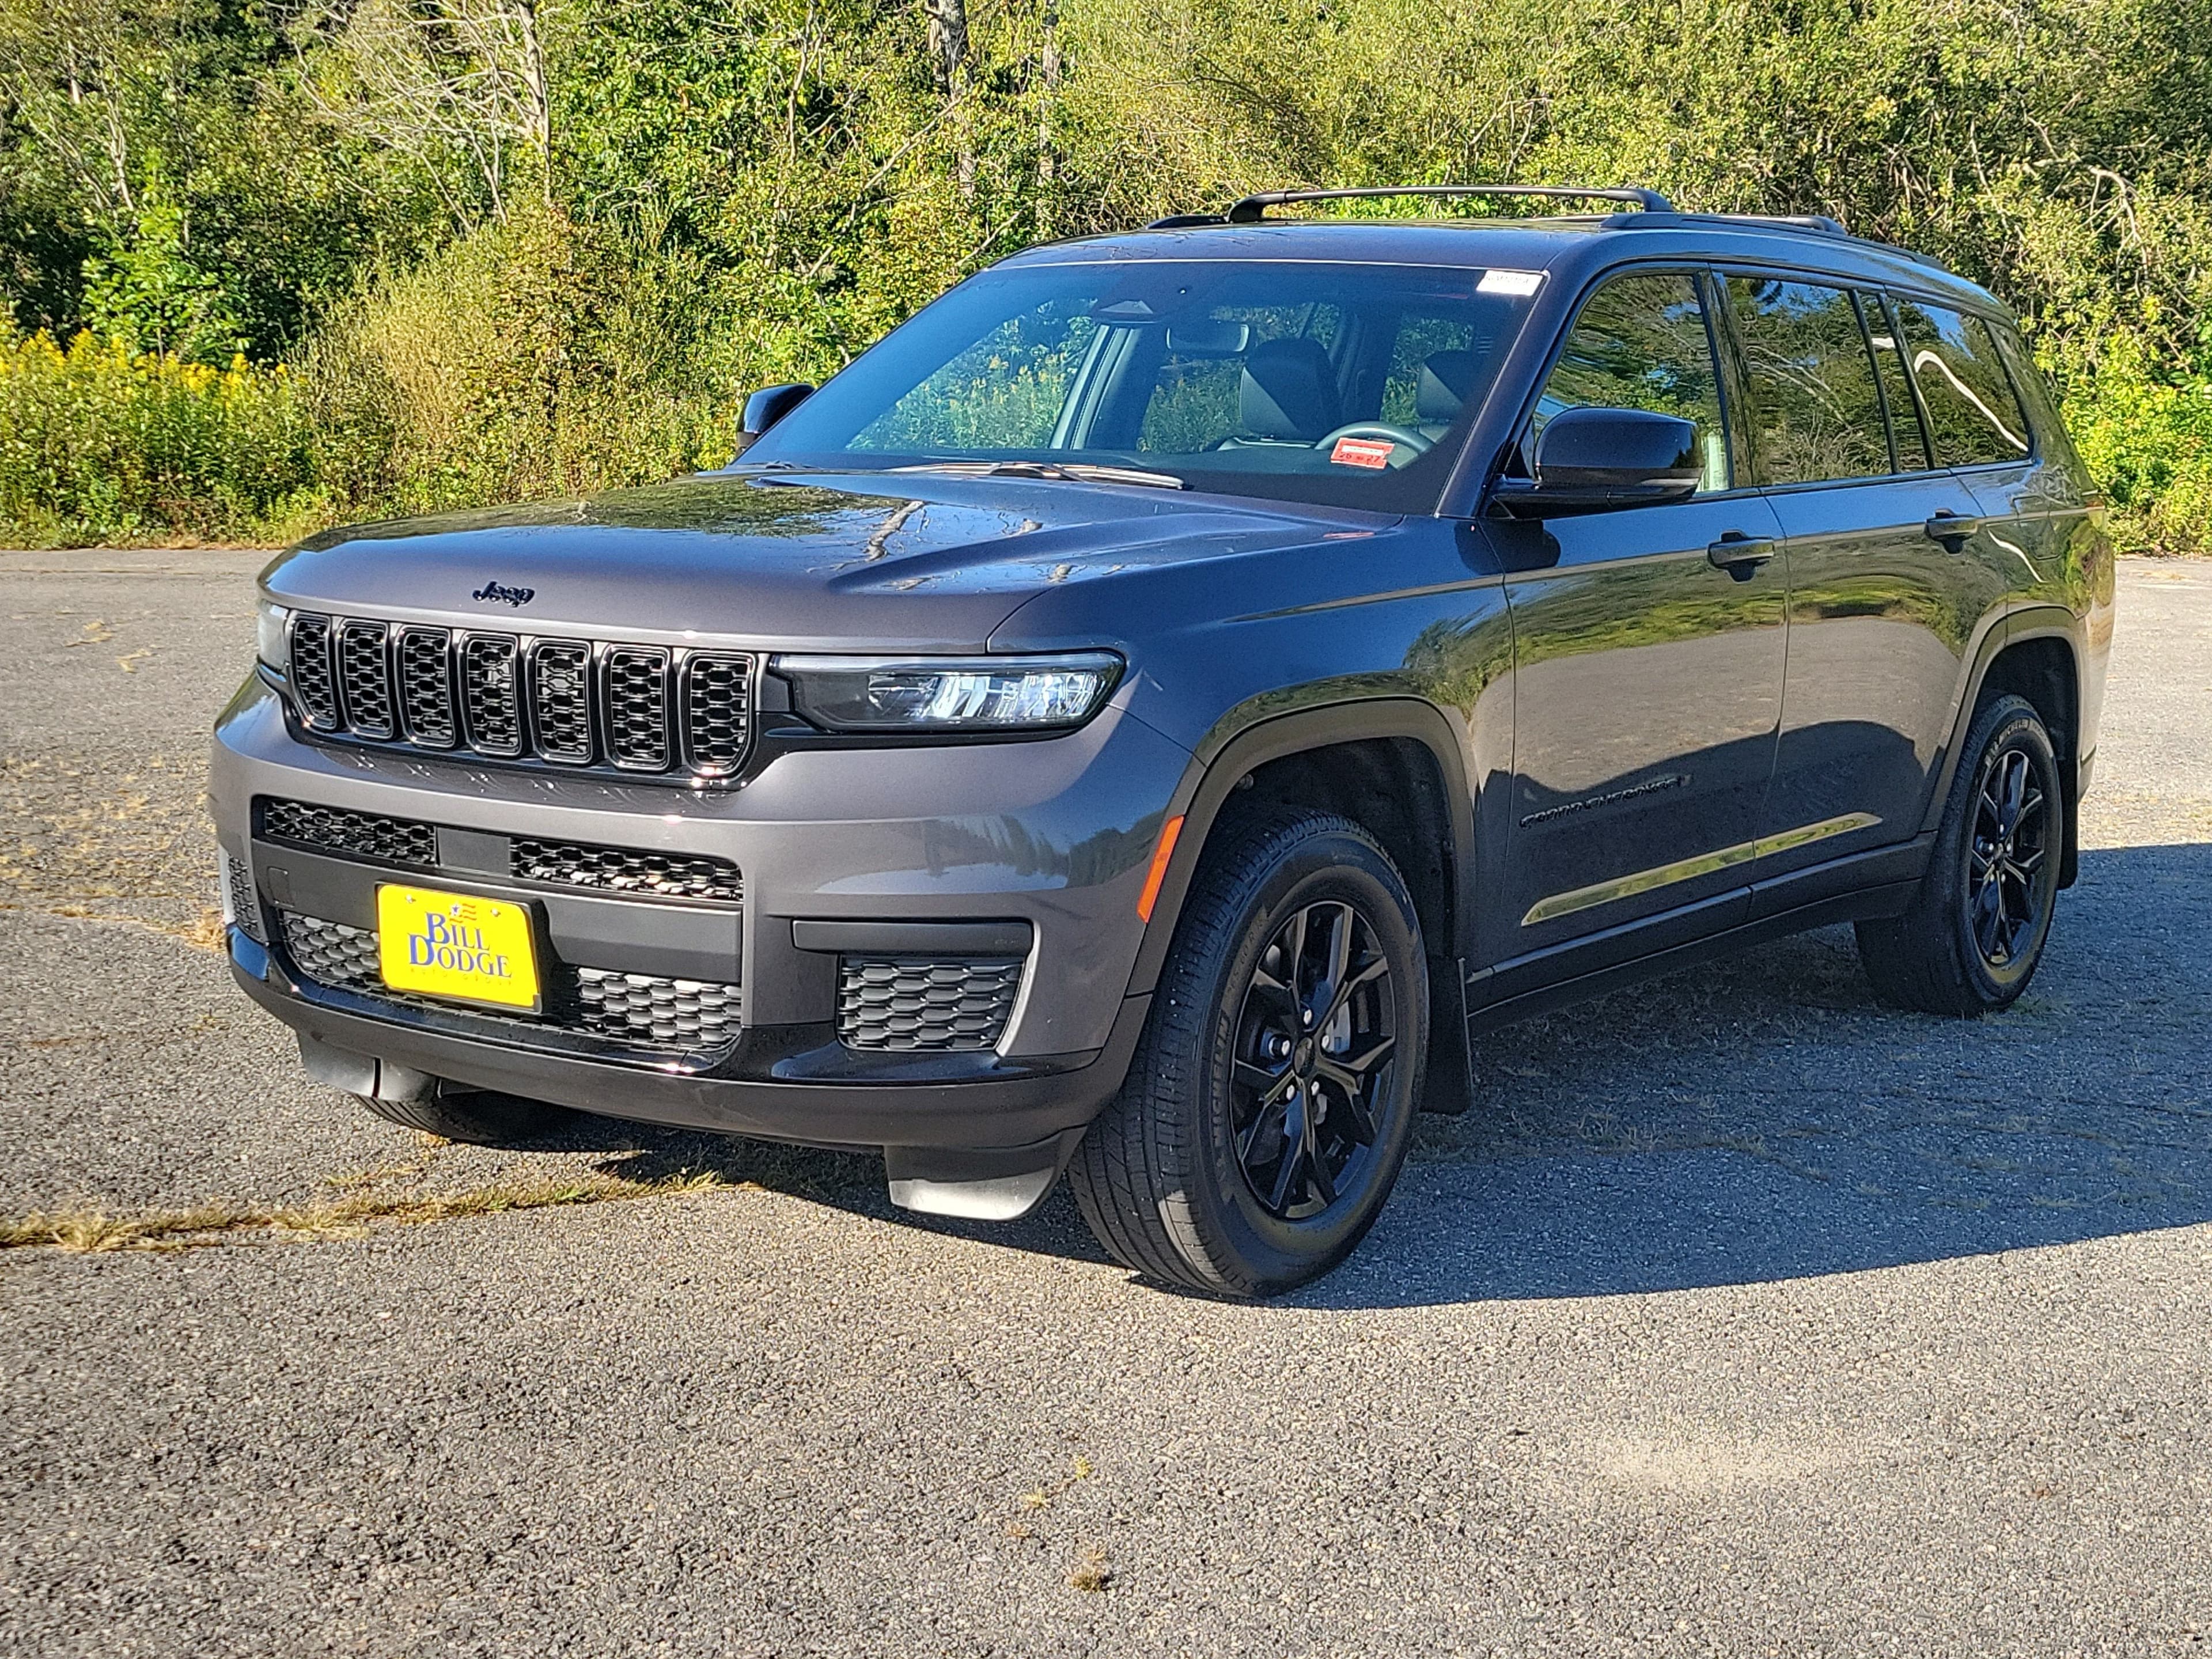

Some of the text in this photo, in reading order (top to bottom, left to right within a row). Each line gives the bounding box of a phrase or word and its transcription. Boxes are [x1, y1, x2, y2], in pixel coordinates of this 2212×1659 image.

[472, 581, 535, 608] Jeep
[425, 911, 490, 950] BILL
[407, 932, 512, 978] DODGE
